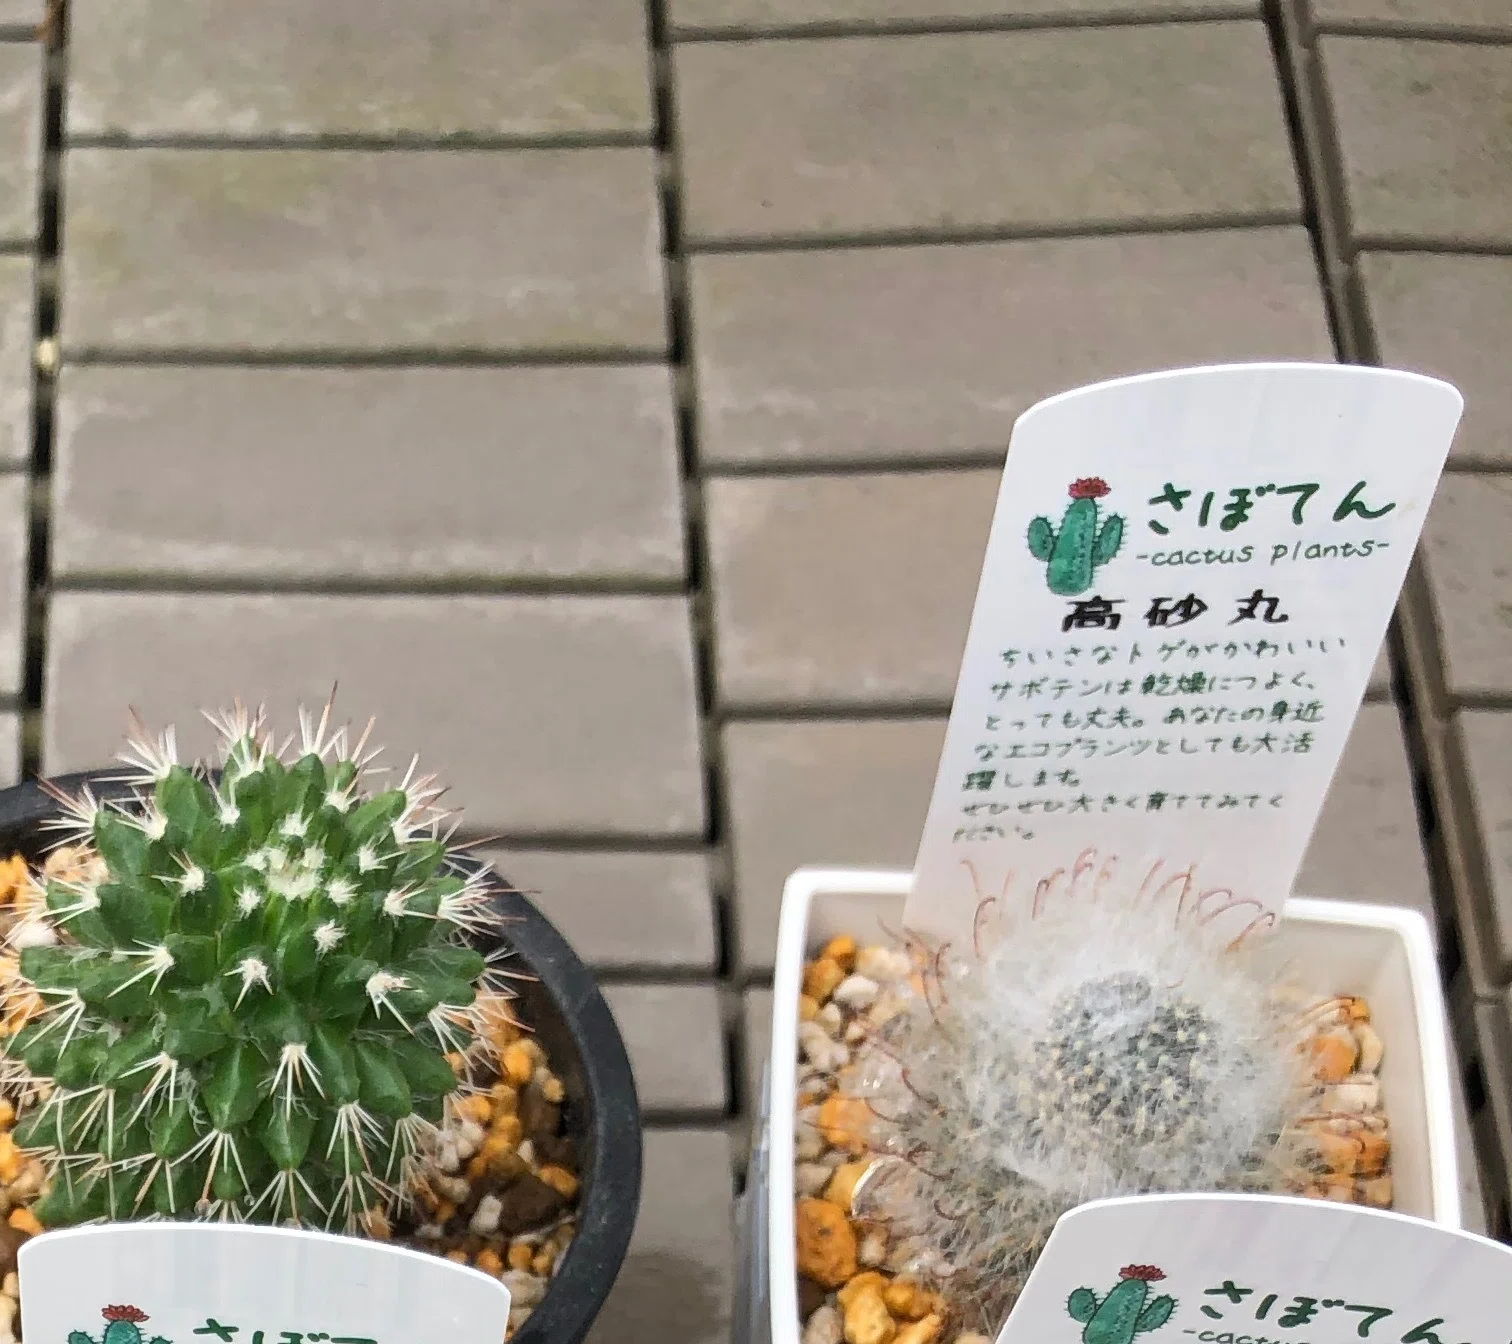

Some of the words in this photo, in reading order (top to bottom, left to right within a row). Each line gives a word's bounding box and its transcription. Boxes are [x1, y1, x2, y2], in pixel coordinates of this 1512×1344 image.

[1148, 481, 1397, 535] さぼてん
[1061, 590, 1290, 632] 高砂丸
[1000, 639, 1345, 666] ちいさなトゲがかわいい
[974, 731, 1314, 762] なエコプランツとしても大活
